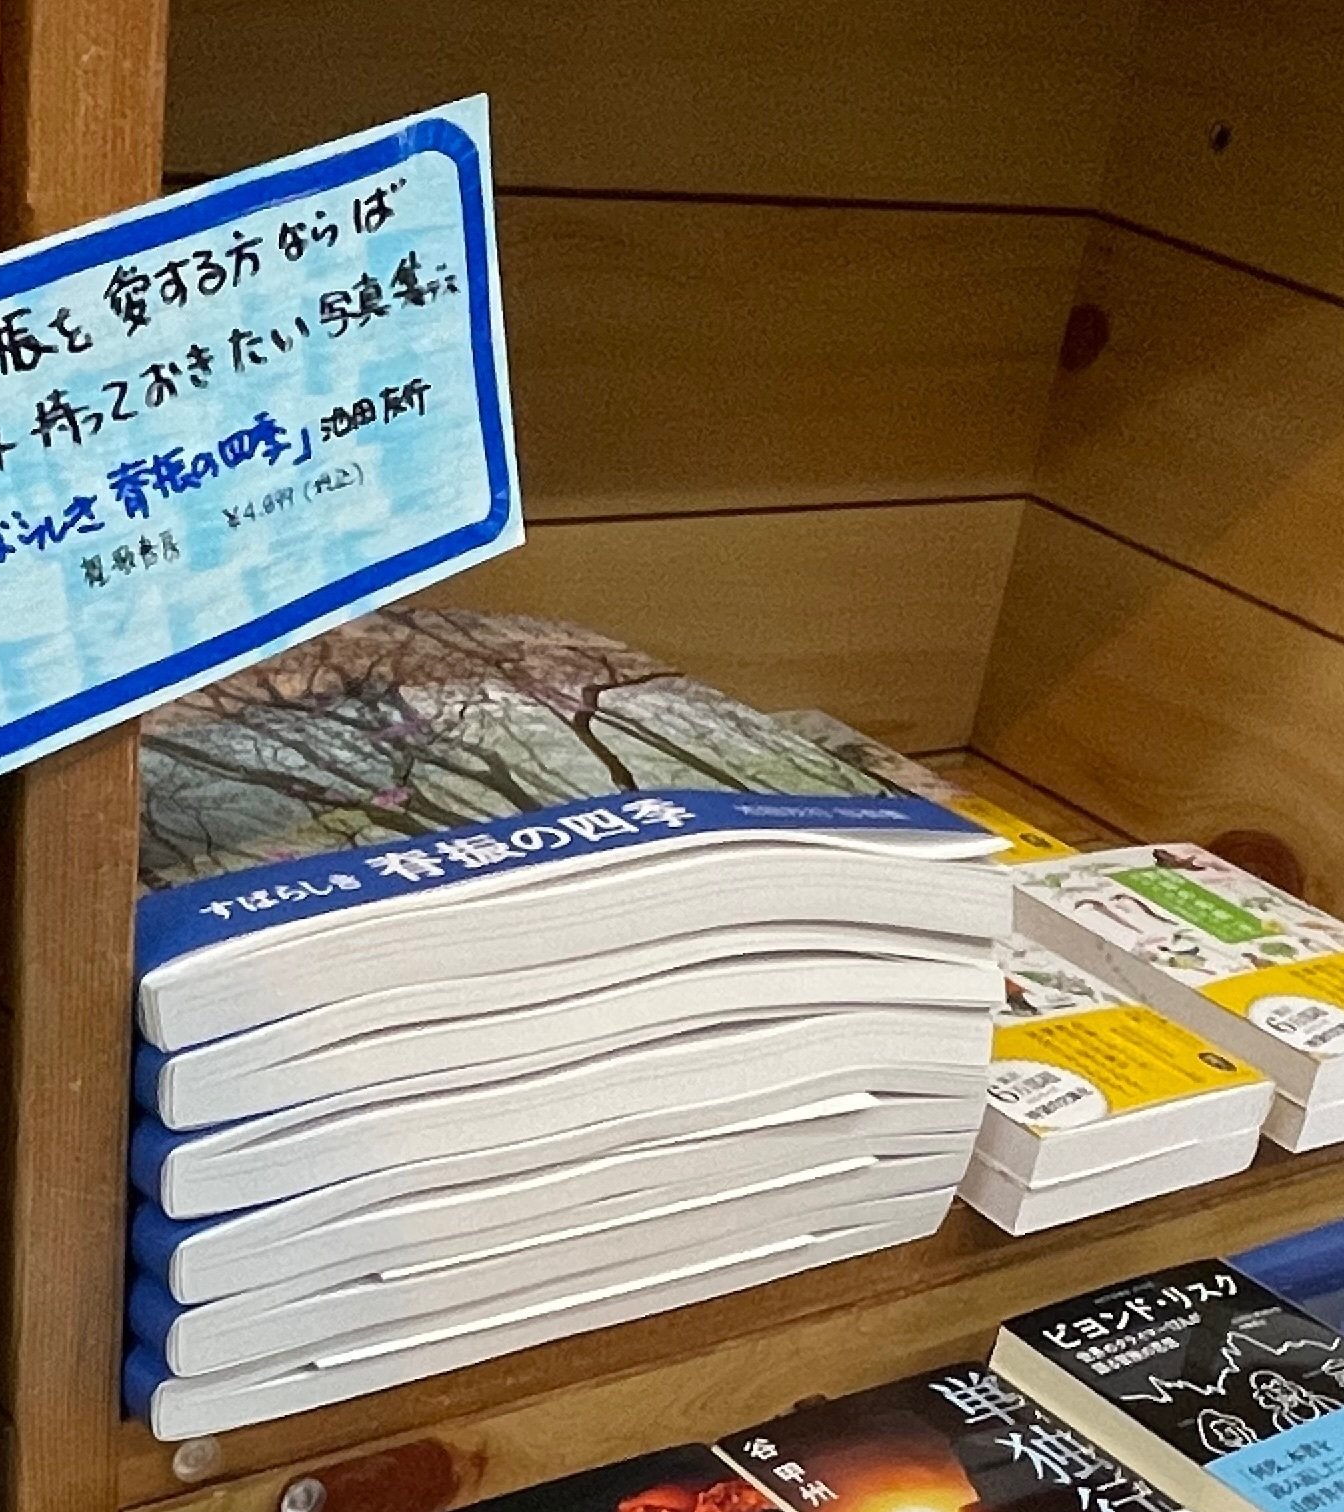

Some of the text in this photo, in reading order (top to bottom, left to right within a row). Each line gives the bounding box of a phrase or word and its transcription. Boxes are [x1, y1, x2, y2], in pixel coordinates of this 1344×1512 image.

[198, 797, 697, 923] すばらしき 脊振の四季
[1042, 1272, 1239, 1350] ビヨンド・リスク
[745, 1437, 841, 1506] 谷 甲州
